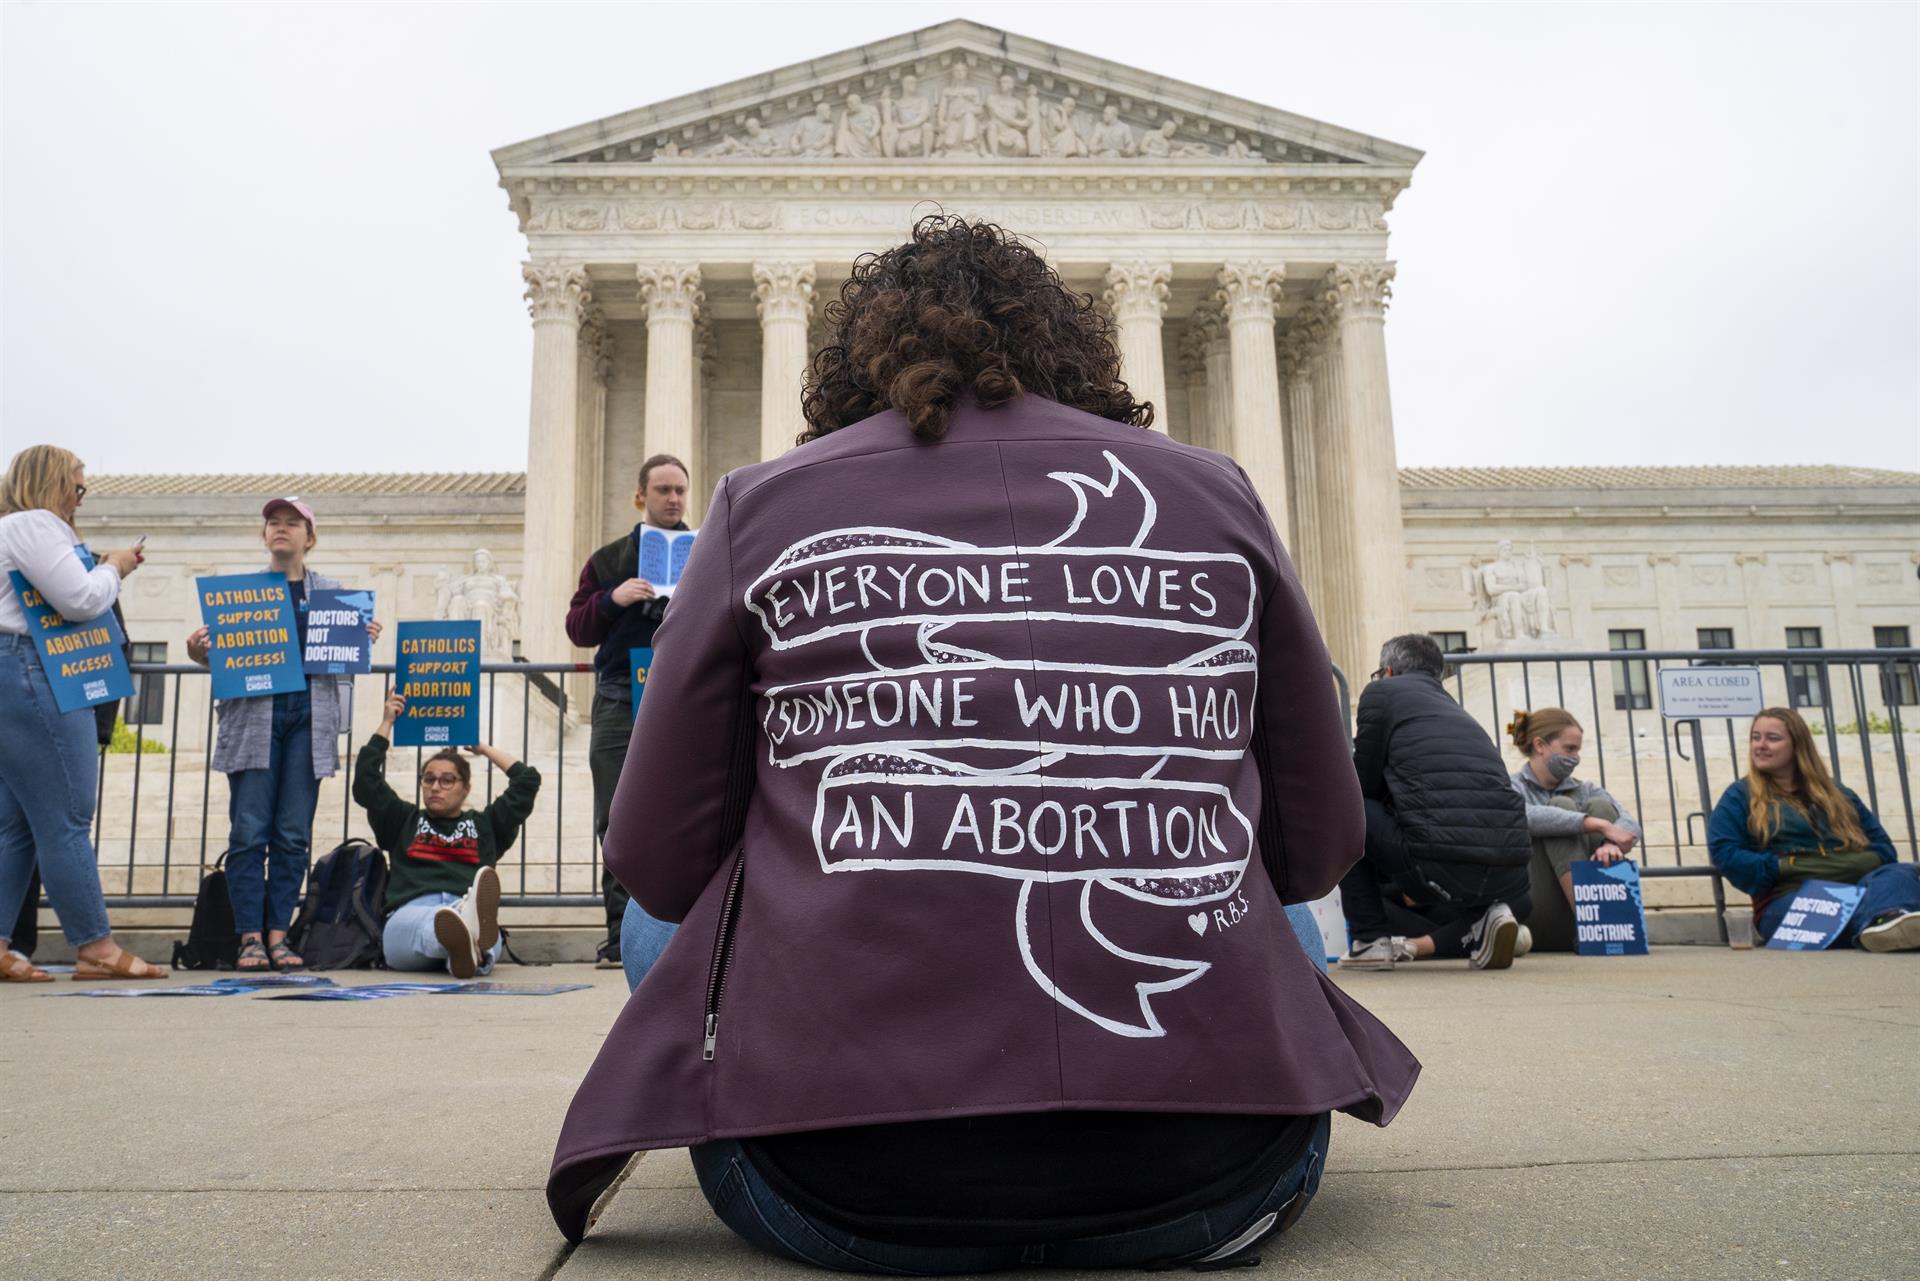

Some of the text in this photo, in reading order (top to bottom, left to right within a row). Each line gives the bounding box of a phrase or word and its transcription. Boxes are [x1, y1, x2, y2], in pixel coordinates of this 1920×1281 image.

[205, 587, 285, 606] CATHOLICS
[765, 562, 1217, 628] EVERYONE LOVES
[217, 608, 280, 625] SUPPORT
[308, 610, 359, 626] DOCTORS
[46, 628, 111, 656] ABORTION
[216, 628, 288, 648] ABORTION
[306, 628, 329, 643] NOT
[305, 646, 360, 662] DOCTRINE
[402, 638, 476, 654] CATHOLICS
[62, 653, 113, 677] ACCESS!
[225, 651, 286, 670] ACCESS!
[408, 661, 468, 674] SUPPORT
[403, 682, 471, 697] ABORTION
[1672, 676, 1750, 687] AREA CLOSED
[408, 705, 465, 719] ACCESS!
[772, 677, 1239, 745] SOMEONE WHO HAD
[830, 791, 1228, 859] AN ABORTION
[1574, 884, 1627, 902] DOCTORS
[1213, 889, 1249, 932] R.B.S.
[1575, 904, 1600, 922] NOT
[1790, 896, 1841, 916] DOCTORS
[1781, 911, 1807, 927] NOT
[1577, 923, 1636, 942] DOCTRINE
